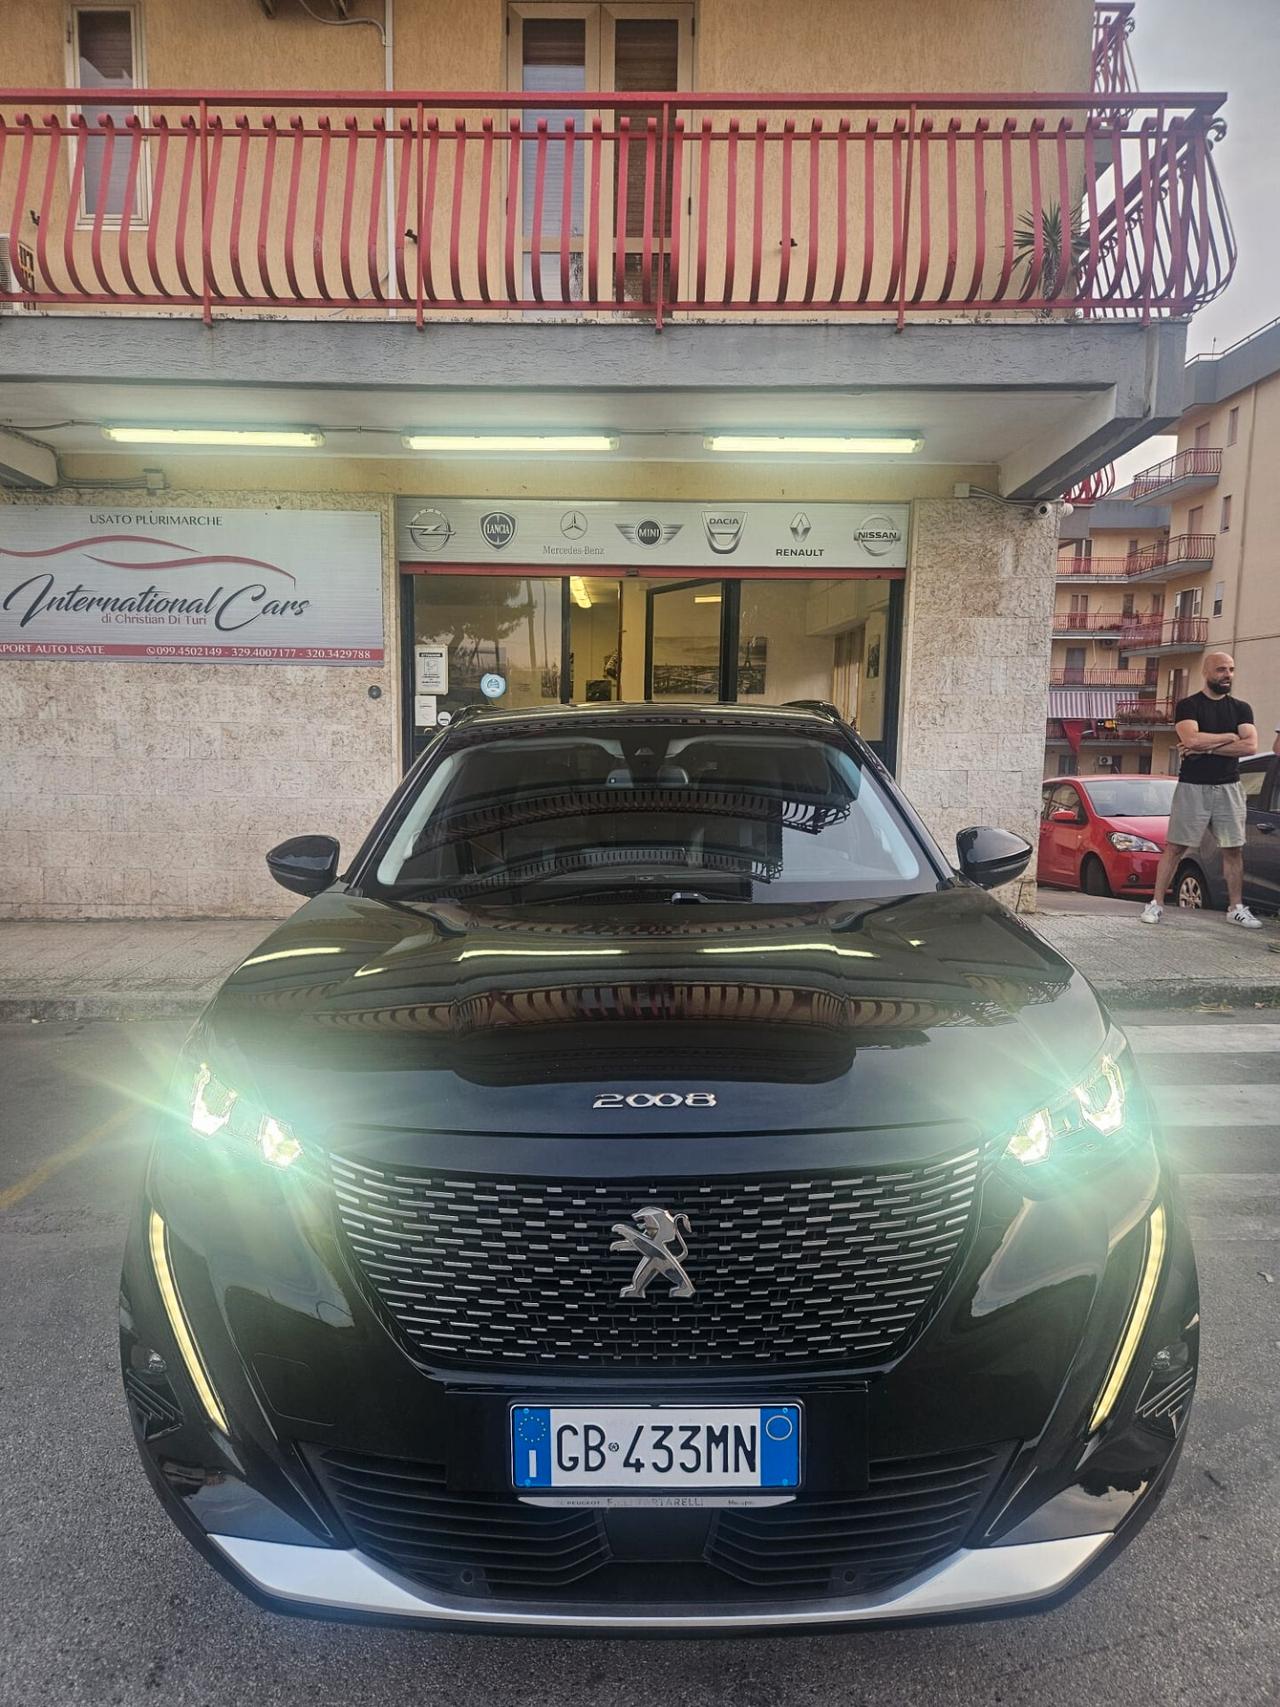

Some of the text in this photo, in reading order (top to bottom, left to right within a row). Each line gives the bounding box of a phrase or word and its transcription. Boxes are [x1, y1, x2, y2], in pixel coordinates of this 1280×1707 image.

[89, 514, 223, 526] USATO PLURIMARCHE
[709, 518, 740, 526] DACIA
[486, 524, 510, 535] LANCIA
[638, 528, 660, 538] MINI
[857, 531, 898, 540] NISSAN
[543, 545, 605, 555] Mercedes-Benz
[776, 548, 824, 557] RENAULT
[3, 573, 312, 631] International Cars
[101, 613, 207, 625] di Christian Di Turi
[35, 644, 67, 654] AUTO
[70, 645, 105, 655] USATE
[156, 646, 371, 659] 099.4502149 329.4007177 320.3429788
[592, 1093, 718, 1109] 2008
